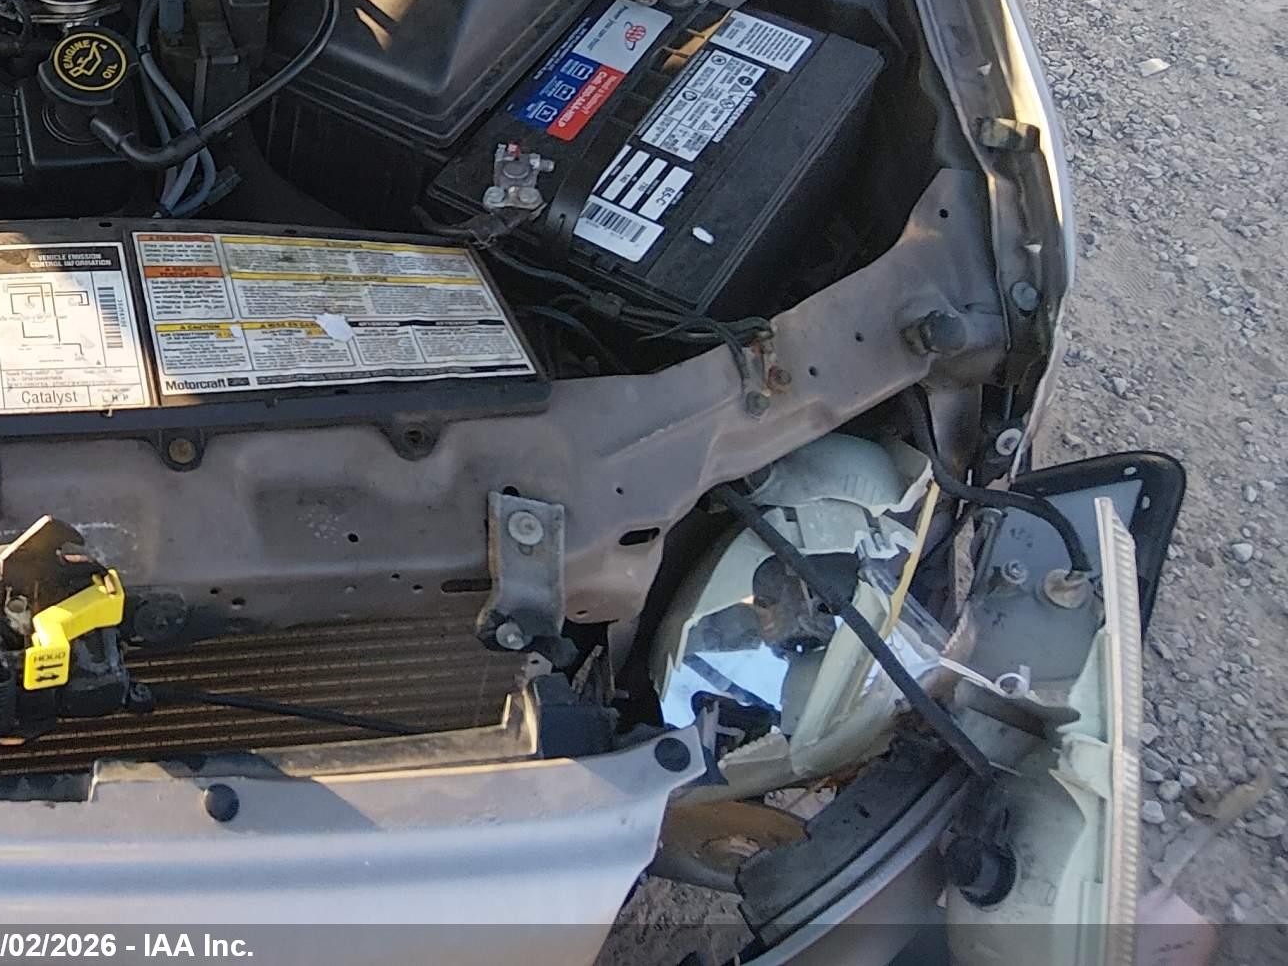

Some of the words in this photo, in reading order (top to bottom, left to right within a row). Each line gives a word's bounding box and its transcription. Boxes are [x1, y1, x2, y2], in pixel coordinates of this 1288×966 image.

[63, 40, 91, 70] ENGINE
[102, 63, 118, 79] OIL
[38, 253, 66, 261] VEHICLE
[68, 252, 102, 261] EMISSION
[30, 260, 63, 268] CONTROL
[64, 259, 112, 267] INFORMATION
[165, 378, 226, 391] Motorcraft
[21, 389, 79, 405] Catalyst
[33, 650, 66, 663] HOOD
